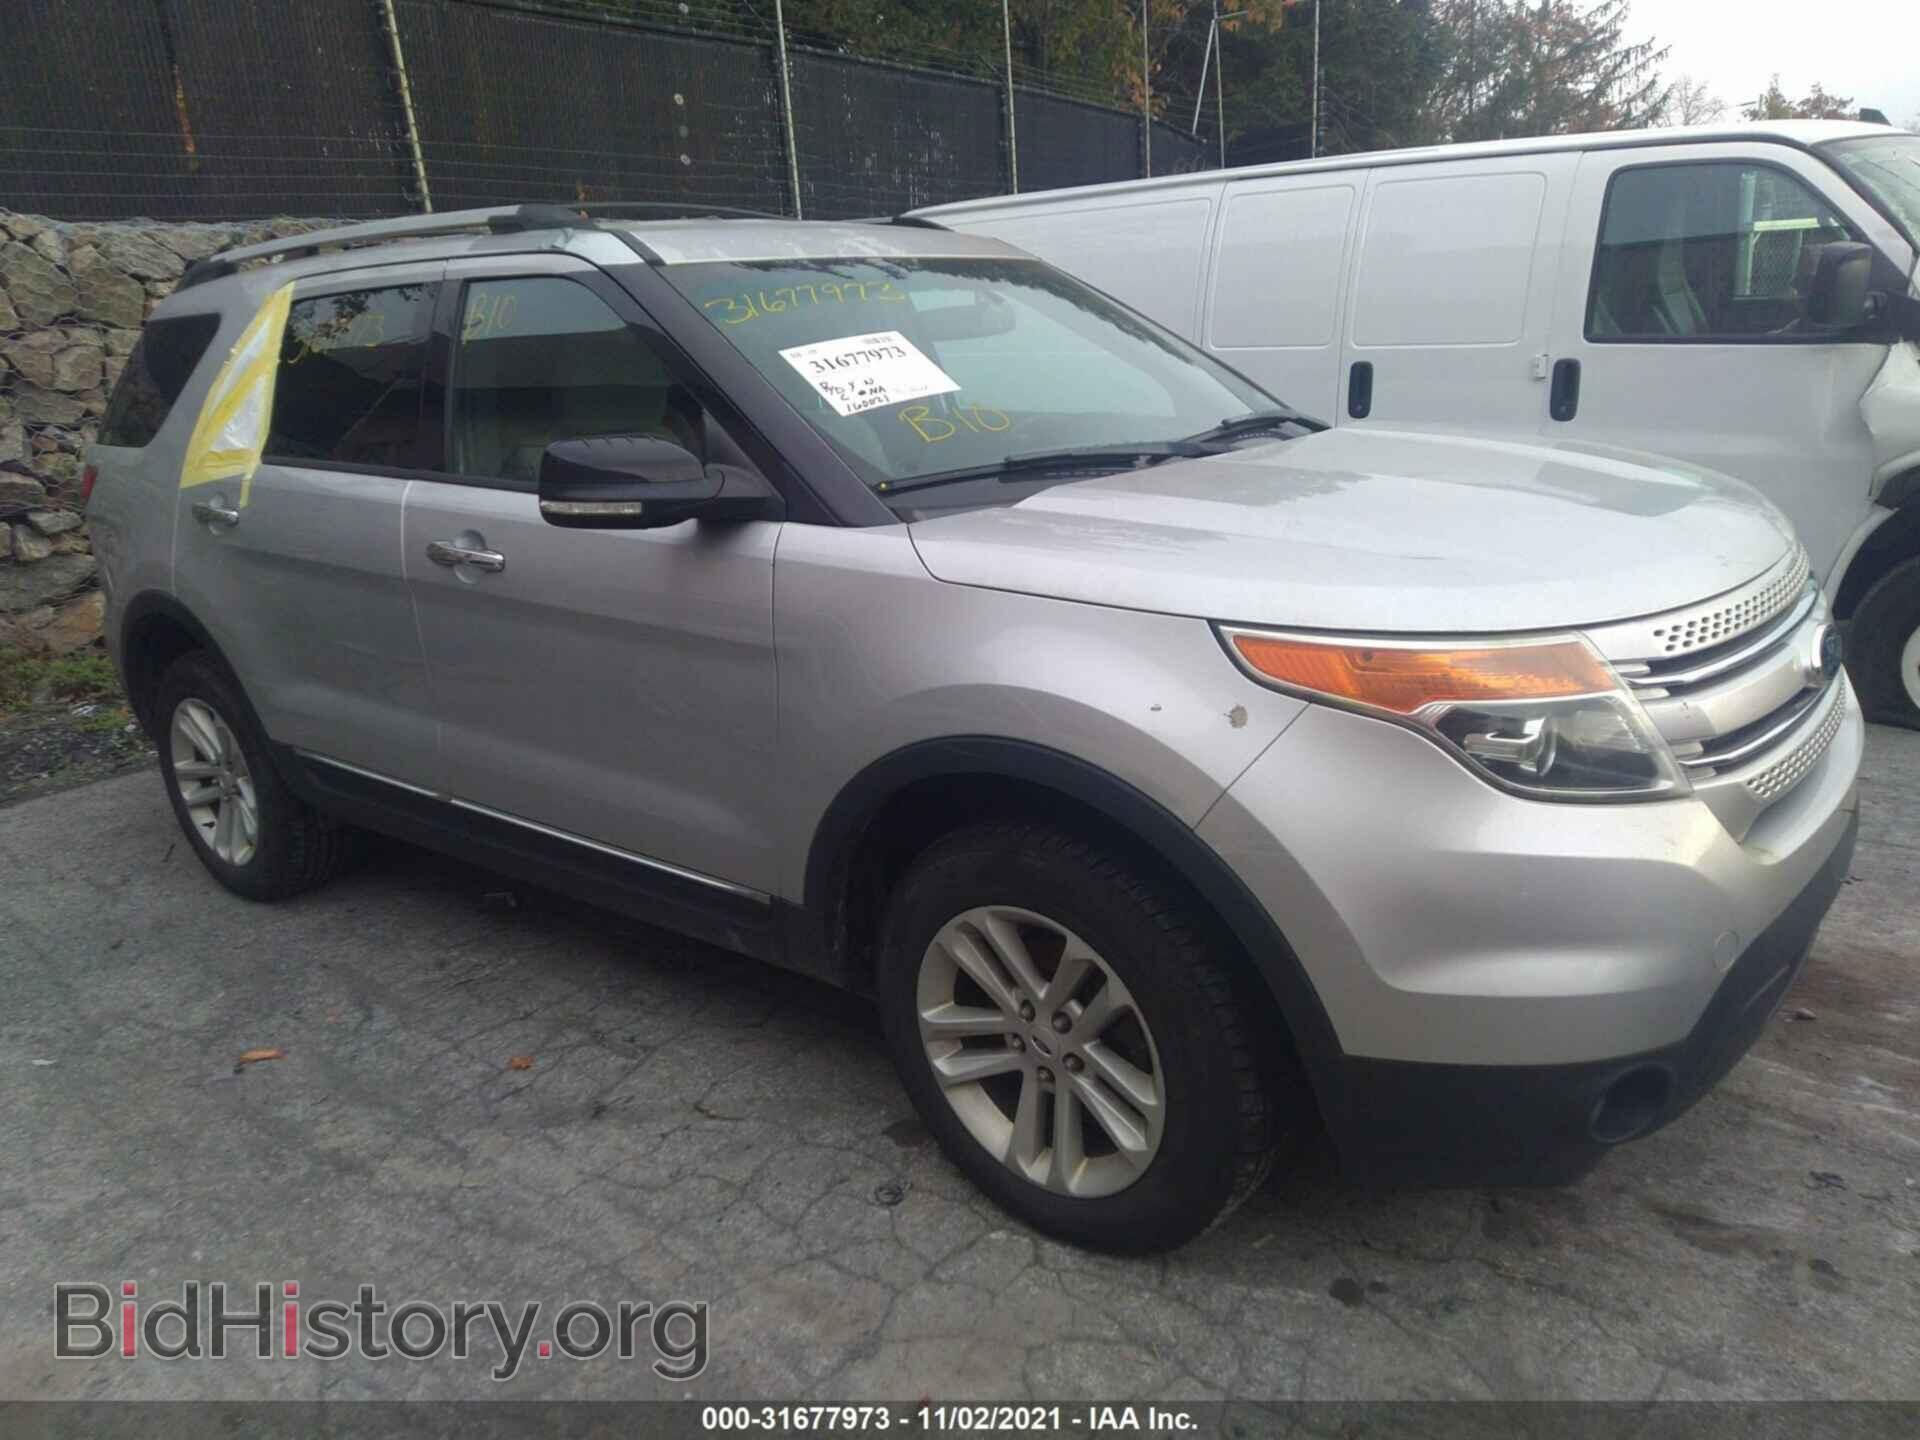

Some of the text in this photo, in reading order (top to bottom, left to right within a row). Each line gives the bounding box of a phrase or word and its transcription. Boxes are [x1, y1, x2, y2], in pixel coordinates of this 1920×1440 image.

[461, 293, 516, 345] B10
[705, 281, 906, 326] 31677973
[808, 346, 907, 373] 31677973
[899, 405, 1011, 442] B10
